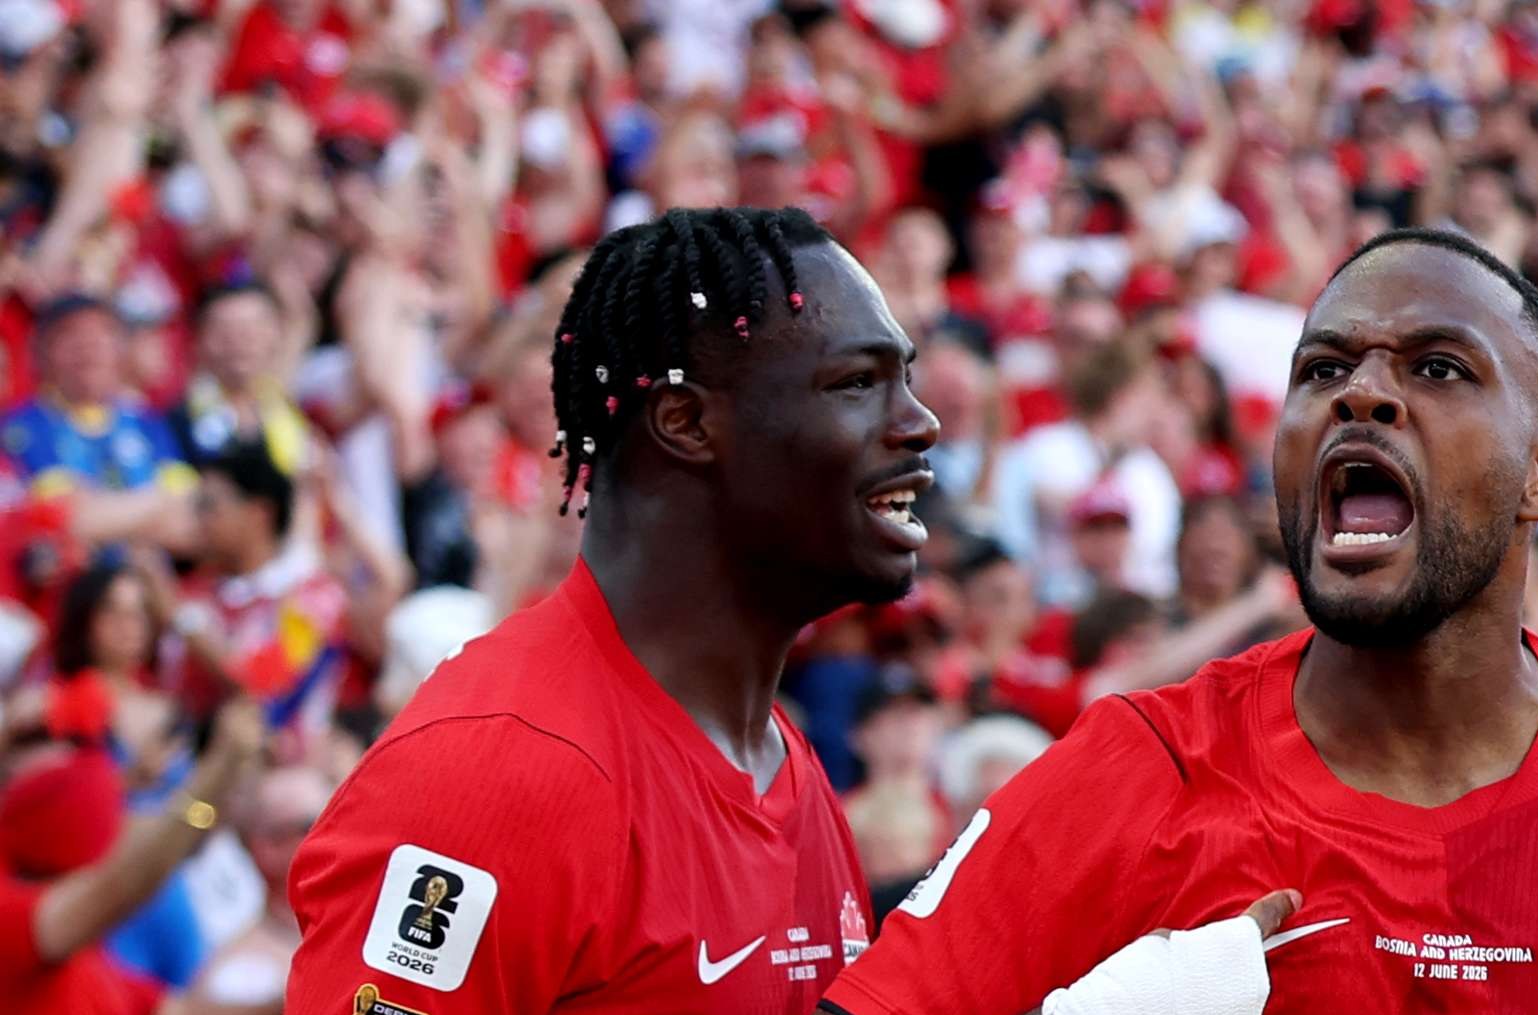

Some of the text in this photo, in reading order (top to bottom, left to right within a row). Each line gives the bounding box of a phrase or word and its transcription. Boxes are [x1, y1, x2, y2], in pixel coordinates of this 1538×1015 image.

[407, 926, 432, 942] FIFA
[1422, 933, 1472, 947] CANADA
[391, 941, 439, 963] WORLD CUP
[1375, 935, 1533, 962] BOSNIA AND HERZEGOVINA
[386, 950, 434, 975] 2026
[1414, 962, 1488, 981] 12 JUNE 2026
